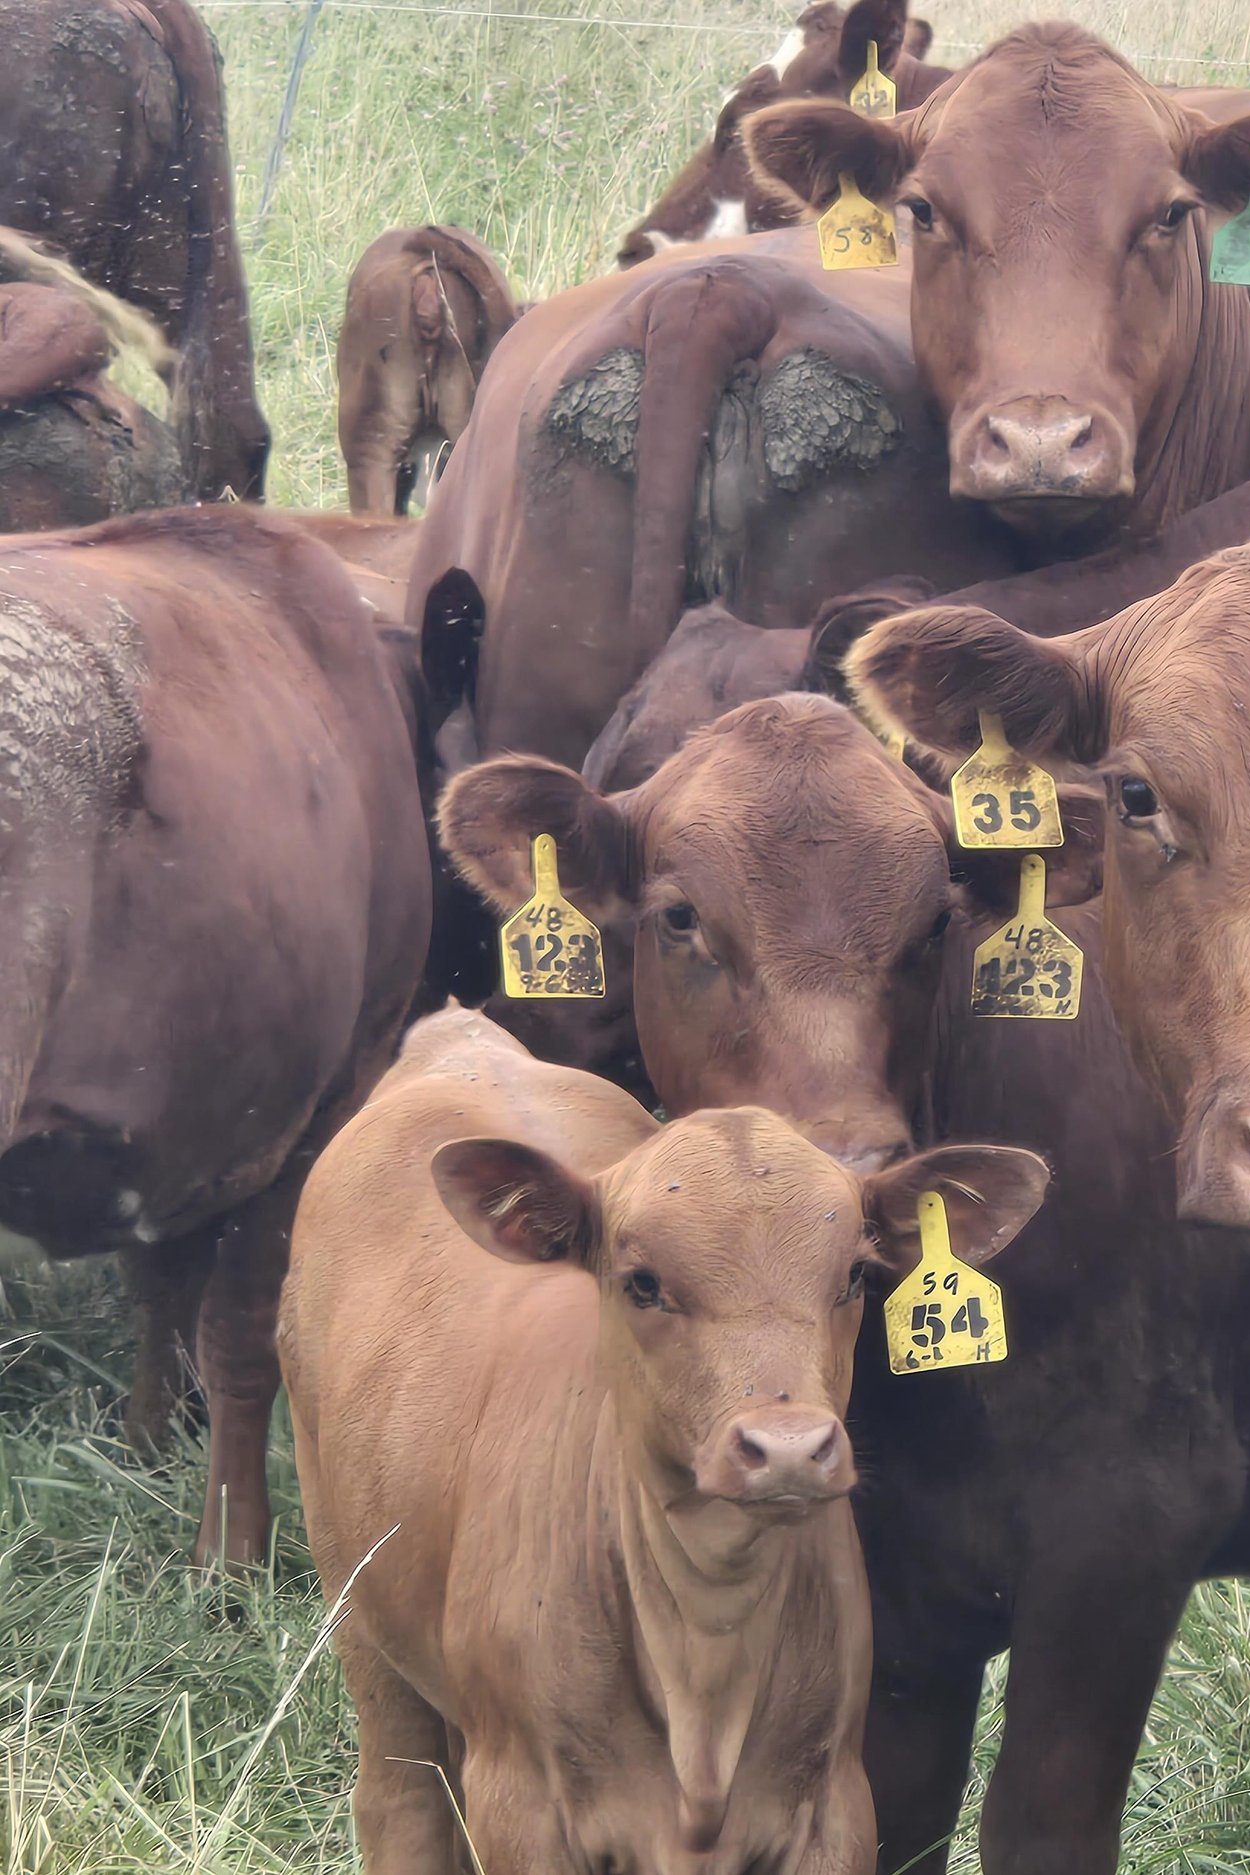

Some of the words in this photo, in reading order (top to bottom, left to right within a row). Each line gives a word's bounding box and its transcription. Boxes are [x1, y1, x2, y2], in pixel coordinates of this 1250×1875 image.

[833, 226, 872, 253] 58
[971, 790, 1041, 834] 35
[525, 903, 562, 932] 48
[1004, 924, 1043, 953] 48
[980, 957, 1072, 999] 123
[922, 1271, 959, 1296] 59
[911, 1296, 989, 1348] 54
[976, 1341, 991, 1362] H
